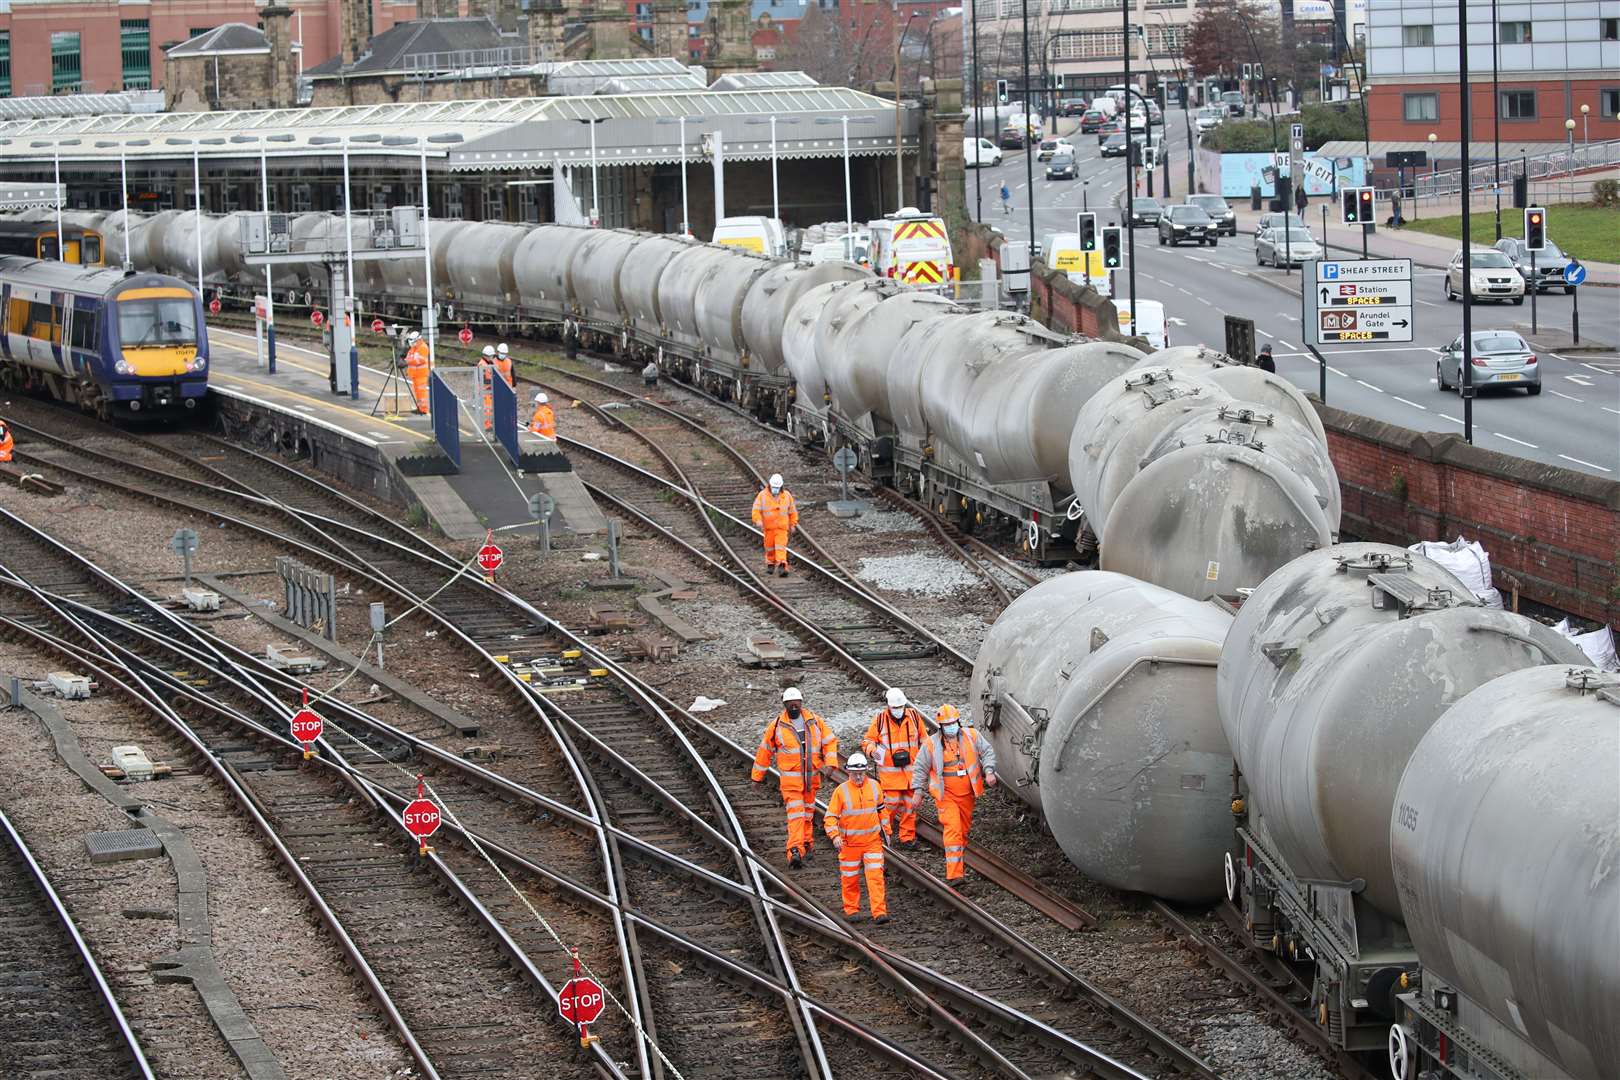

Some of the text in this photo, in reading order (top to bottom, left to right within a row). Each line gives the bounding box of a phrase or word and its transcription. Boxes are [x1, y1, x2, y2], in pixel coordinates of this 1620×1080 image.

[1294, 126, 1301, 137] T
[1340, 267, 1369, 275] SHEAF
[1371, 266, 1404, 274] STREET
[1347, 297, 1380, 305] SPACES
[1339, 332, 1373, 340] SPACES
[479, 554, 501, 562] STOP
[293, 721, 322, 732] STOP
[405, 812, 438, 825] STOP
[1398, 801, 1419, 832] 11055
[561, 994, 601, 1010] STOP
